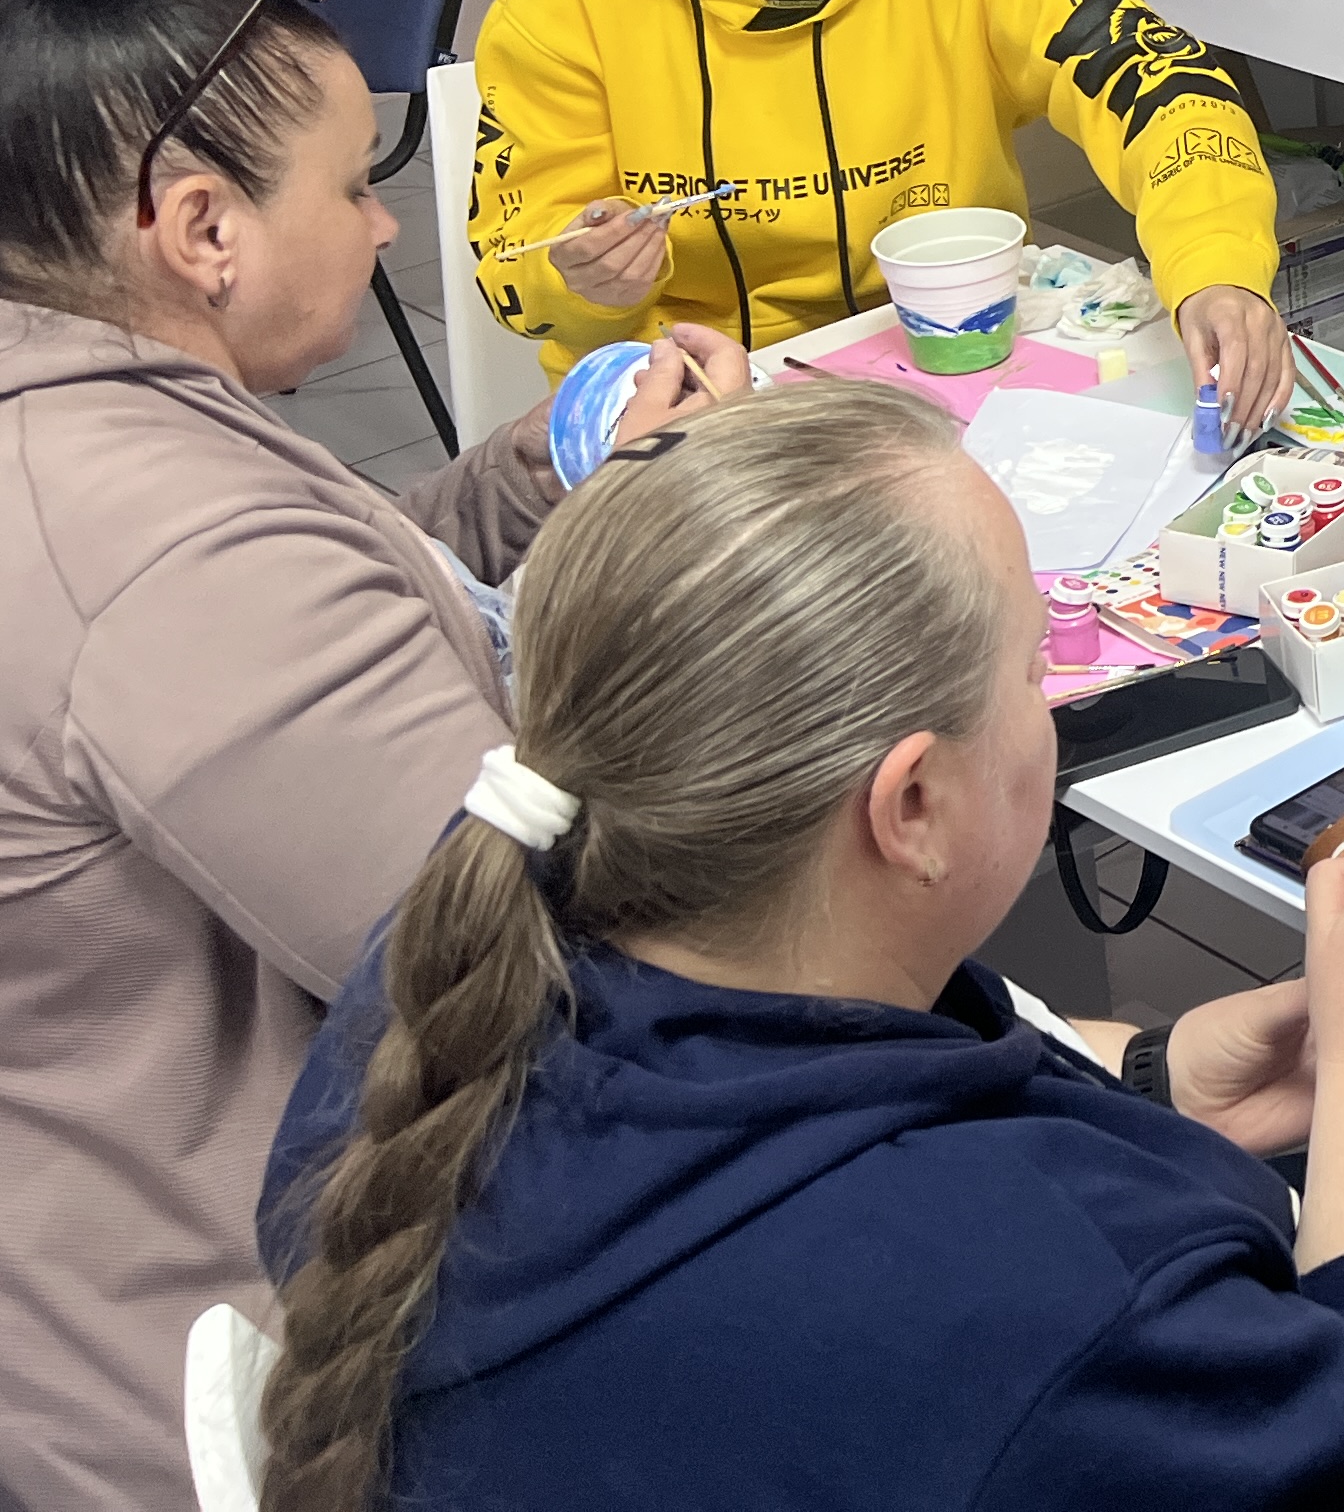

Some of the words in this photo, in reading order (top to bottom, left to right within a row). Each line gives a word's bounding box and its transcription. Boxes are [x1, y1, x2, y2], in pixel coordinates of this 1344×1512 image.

[1150, 164, 1183, 190] FABRIC
[1197, 154, 1218, 163] THE
[756, 175, 807, 201] THE
[1218, 547, 1227, 570] NEW
[1218, 570, 1227, 592] NEW
